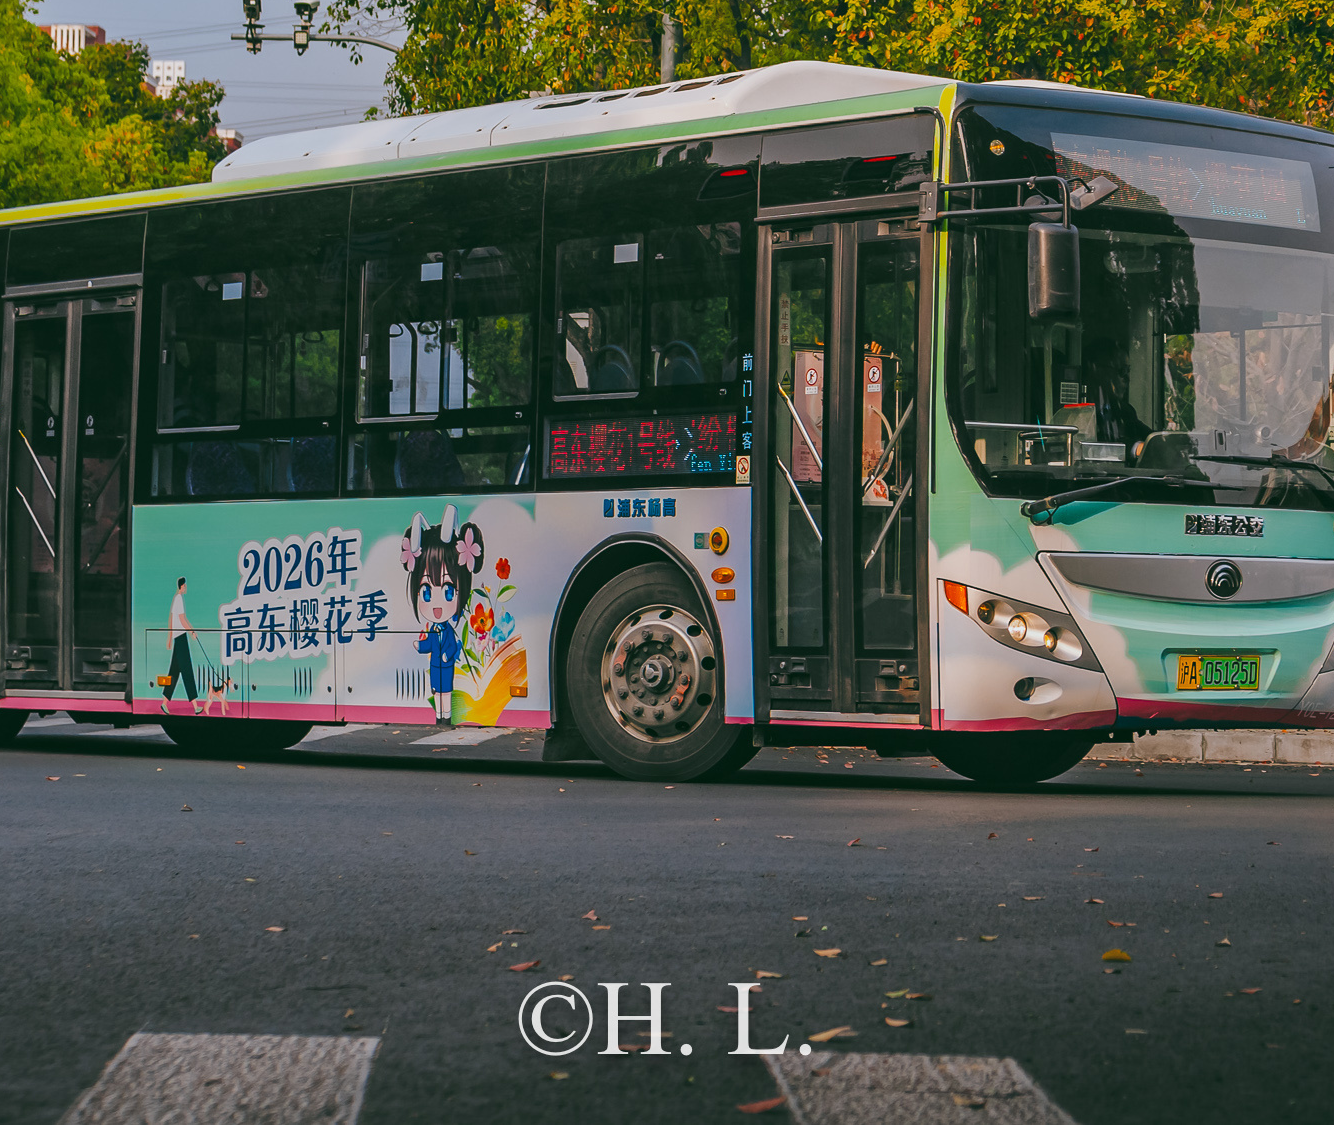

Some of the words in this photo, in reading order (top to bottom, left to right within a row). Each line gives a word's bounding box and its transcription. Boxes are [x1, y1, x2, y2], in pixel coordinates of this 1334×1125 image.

[742, 353, 753, 450] 前门上客
[617, 497, 677, 518] 浦东杨高
[1199, 513, 1264, 537] 浦东公交
[242, 535, 358, 596] 2026年
[223, 589, 389, 658] 高东樱花季
